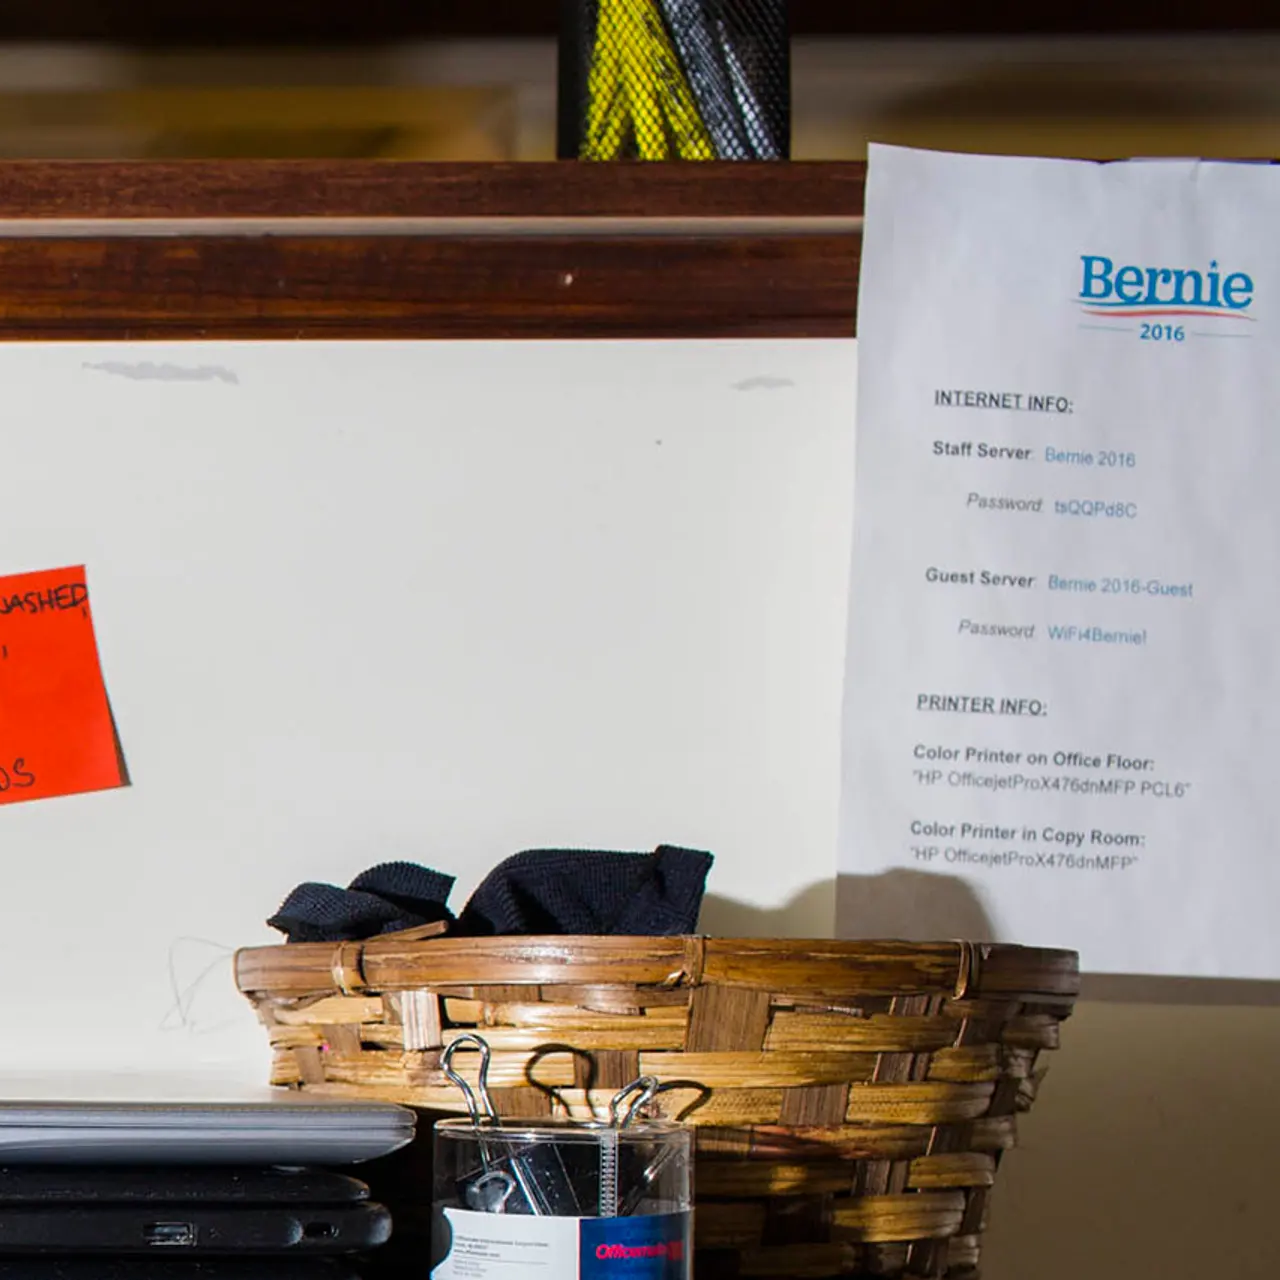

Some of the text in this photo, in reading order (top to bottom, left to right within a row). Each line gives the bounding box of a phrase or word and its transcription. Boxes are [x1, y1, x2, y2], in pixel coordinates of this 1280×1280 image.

[1078, 255, 1254, 309] Bernie
[1139, 323, 1185, 341] 2016
[934, 389, 1075, 414] INTERNET INFO:
[933, 440, 972, 458] Staff
[1045, 446, 1094, 465] Bernie
[1098, 451, 1136, 468] 2016
[925, 567, 975, 585] Guest
[1048, 575, 1097, 592] Bernie
[1101, 578, 1193, 597] 2016-Guest
[916, 693, 1048, 717] PRINTER INFO:
[913, 744, 1155, 771] Color Printer on Office Floor:
[910, 820, 1145, 848] Color Printer in Copy Room:
